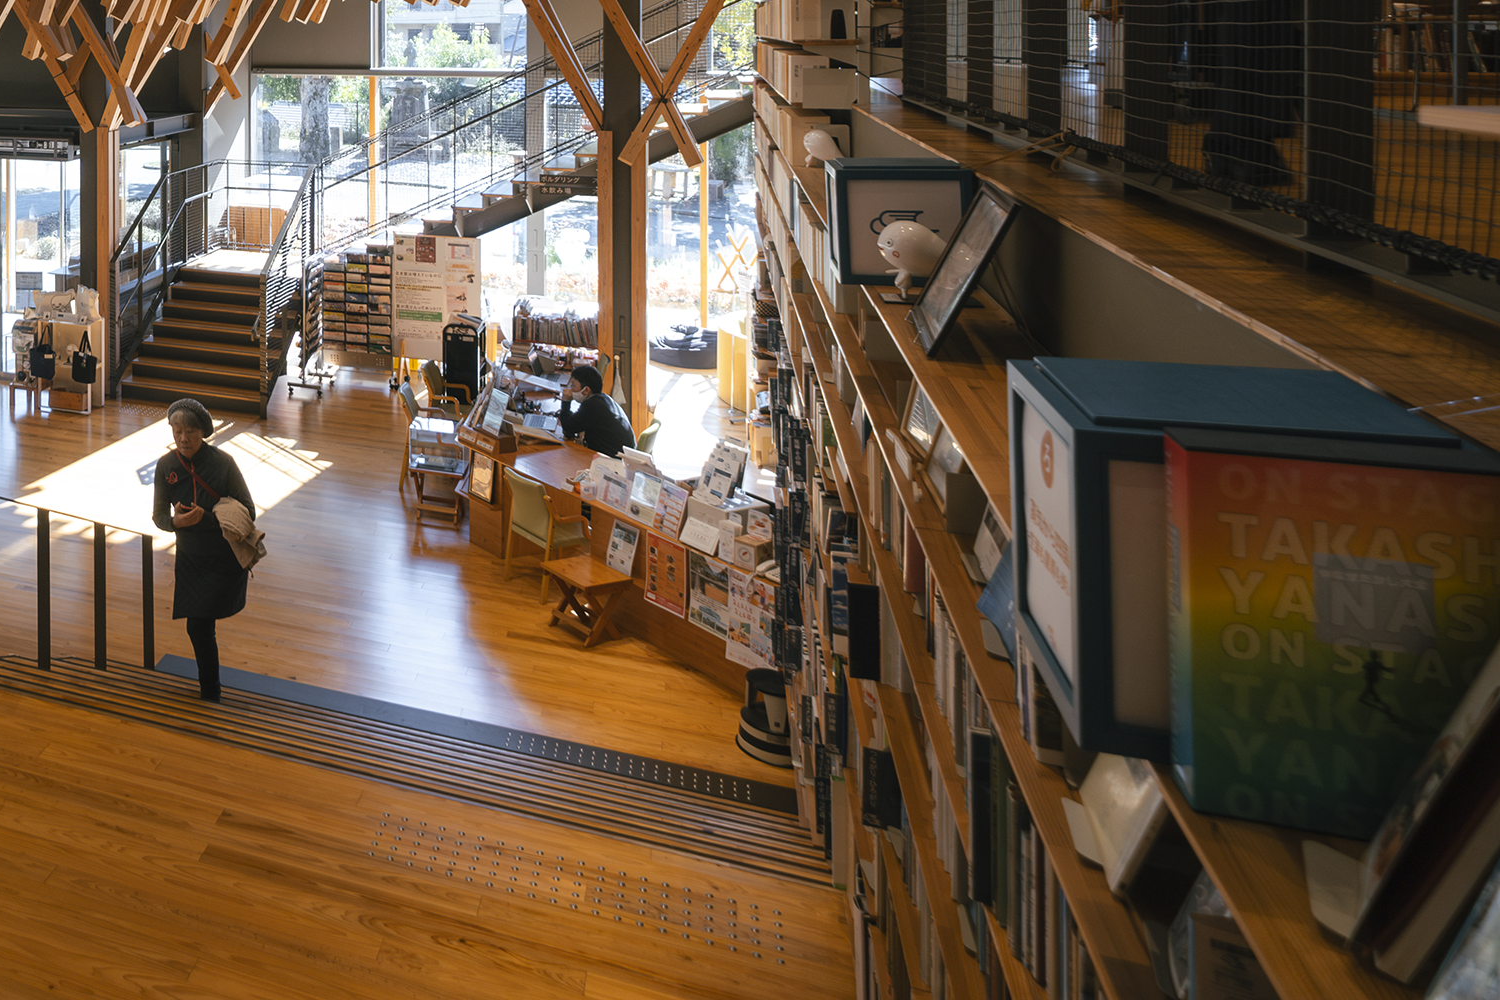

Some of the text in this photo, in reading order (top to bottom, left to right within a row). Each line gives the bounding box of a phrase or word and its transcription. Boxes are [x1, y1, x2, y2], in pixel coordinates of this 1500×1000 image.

[541, 176, 580, 184] ボルダリング
[1220, 622, 1306, 669] ON
